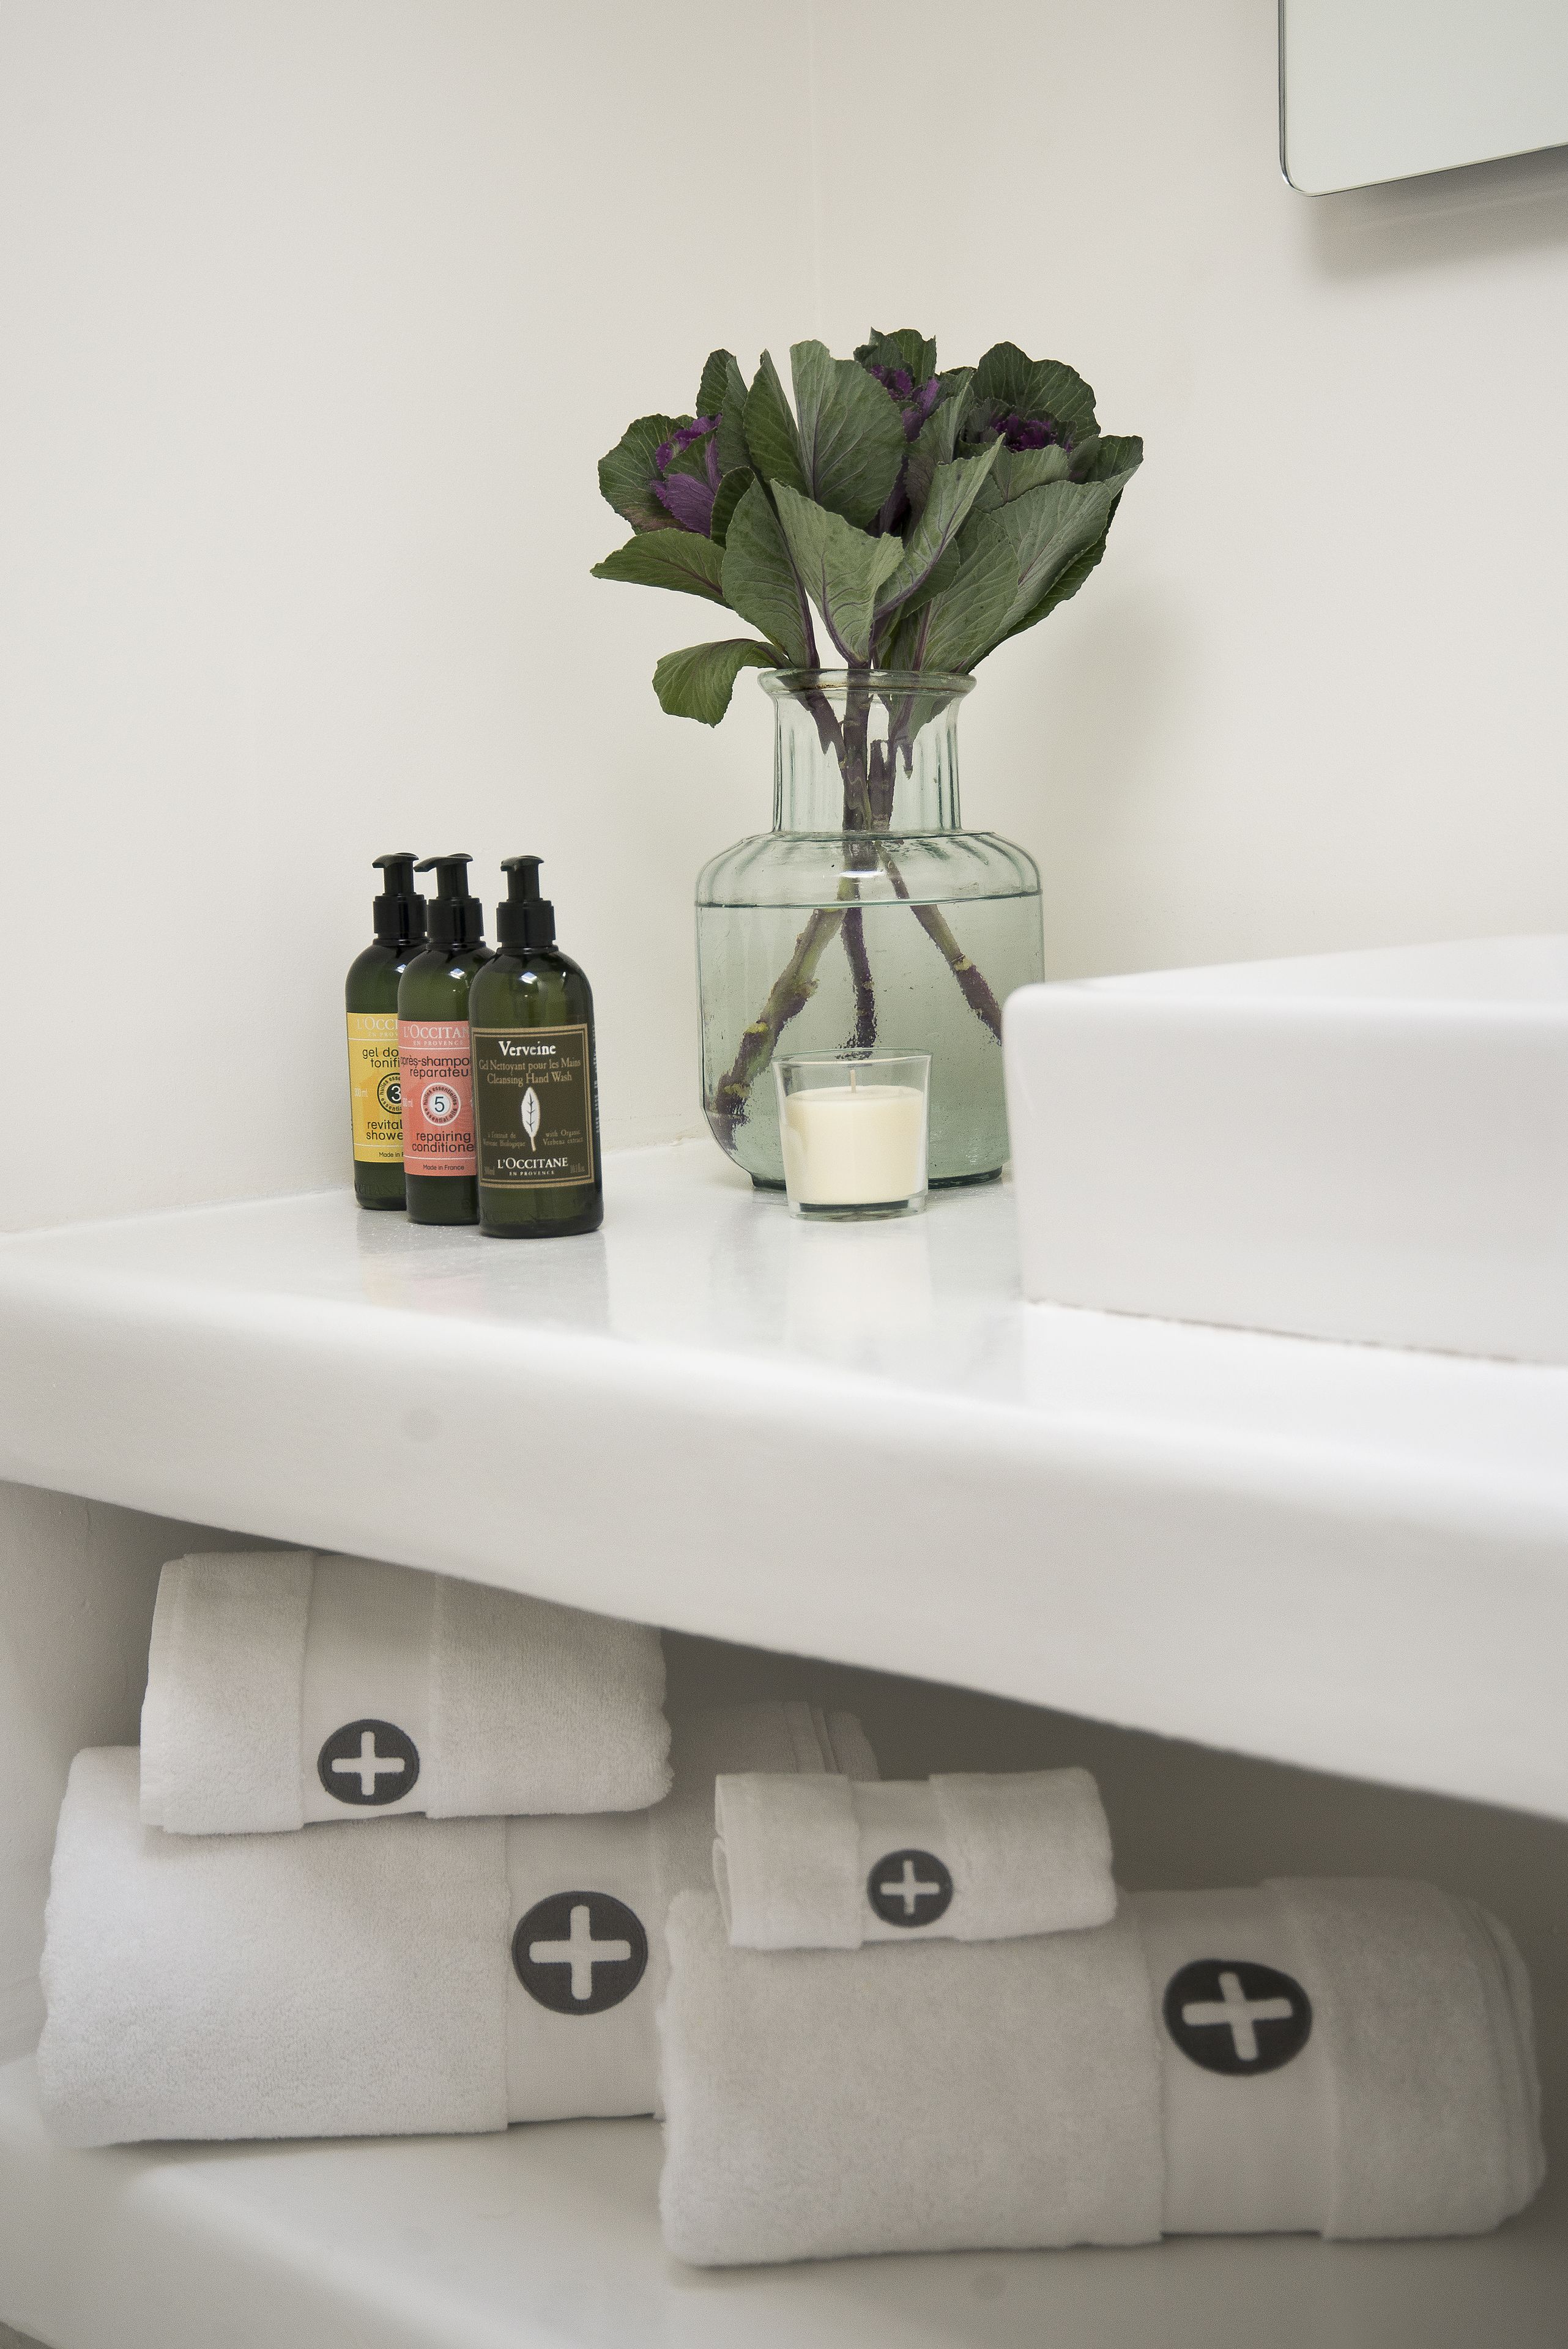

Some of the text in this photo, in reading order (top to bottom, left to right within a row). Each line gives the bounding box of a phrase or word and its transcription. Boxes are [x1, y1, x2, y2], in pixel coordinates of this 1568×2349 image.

[362, 1047, 399, 1059] gel do
[498, 1041, 557, 1056] Verveine
[371, 1057, 400, 1068] tonifi
[478, 1057, 581, 1073] Gel Nettoyant pour les Mains
[487, 1071, 573, 1087] Cleansing Hand Wash
[379, 1080, 388, 1095] huiles
[391, 1085, 401, 1102] 3
[434, 1096, 445, 1113] 5
[367, 1119, 403, 1130] revital
[366, 1132, 403, 1141] showe
[416, 1131, 471, 1143] repairing
[412, 1141, 474, 1152] conditione
[497, 1157, 568, 1170] L'OCCITANE
